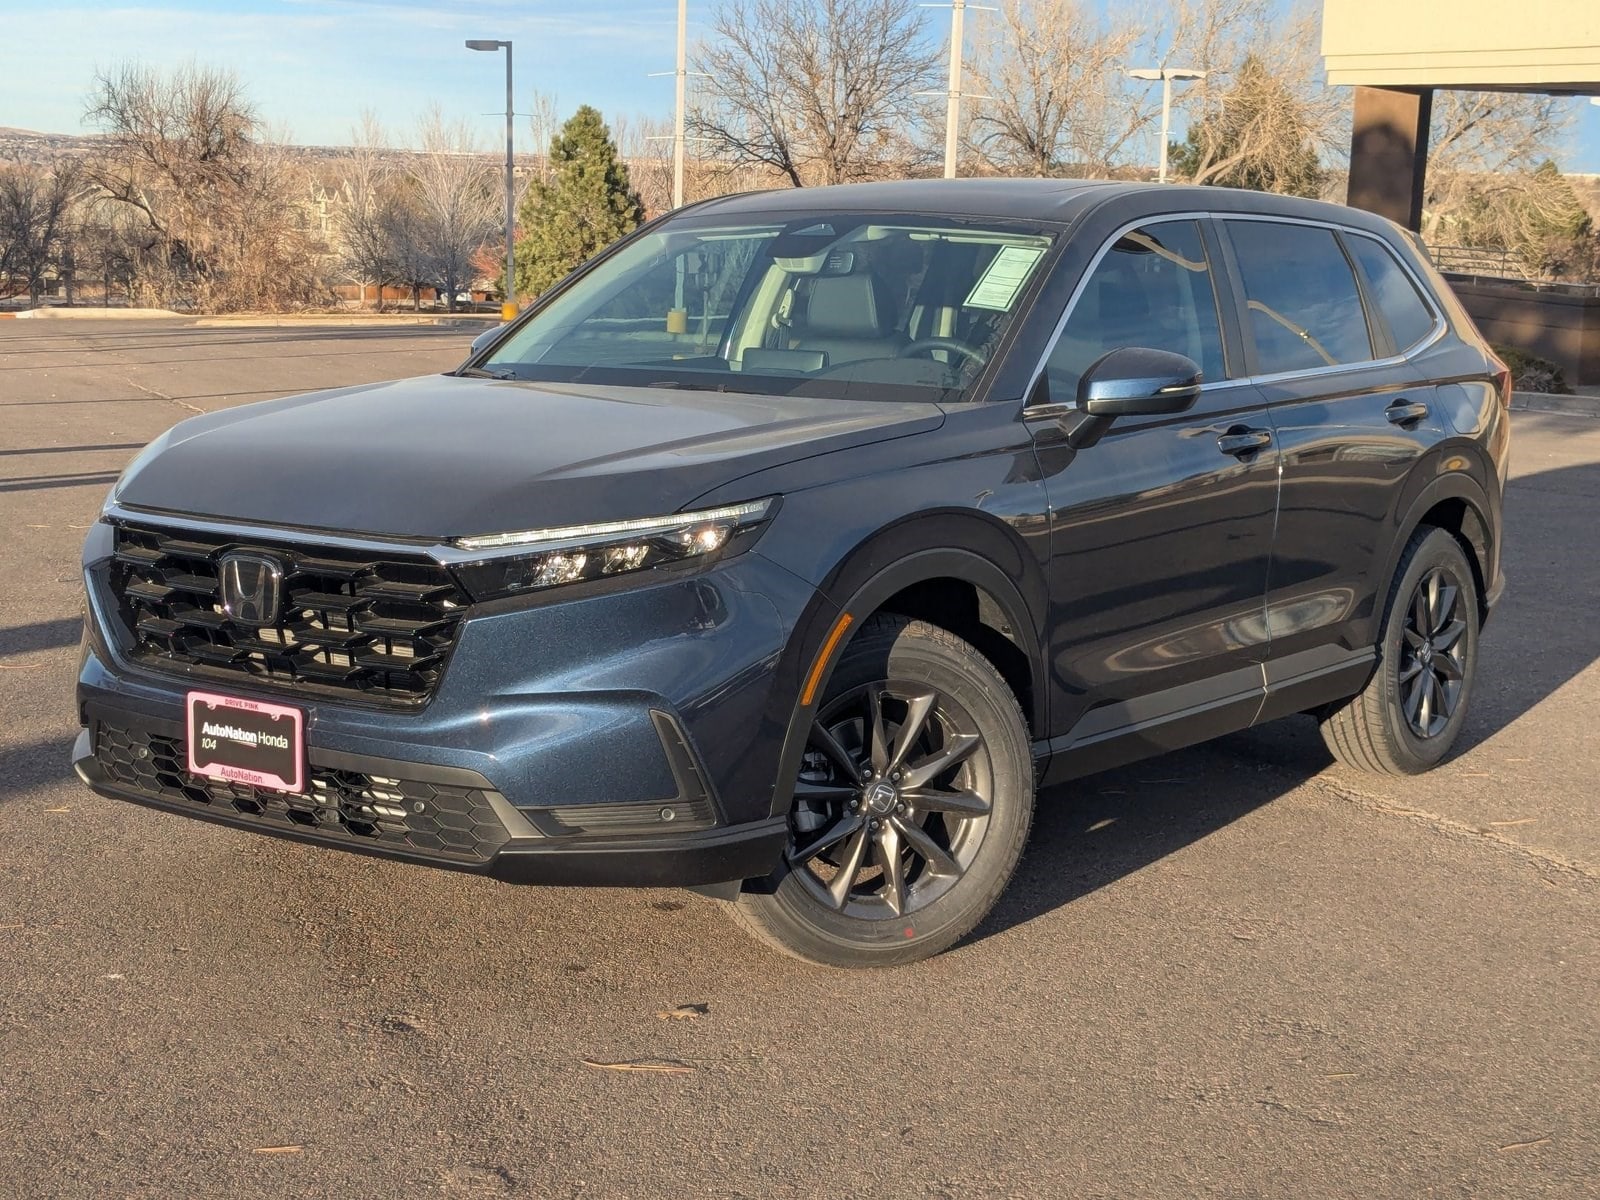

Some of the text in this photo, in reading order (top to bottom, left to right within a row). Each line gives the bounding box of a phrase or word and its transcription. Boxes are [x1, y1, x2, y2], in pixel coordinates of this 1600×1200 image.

[224, 698, 259, 710] DRIVE PINK
[201, 721, 288, 749] AutoNation Honda
[201, 738, 217, 750] 104
[220, 767, 263, 783] AutoNation
